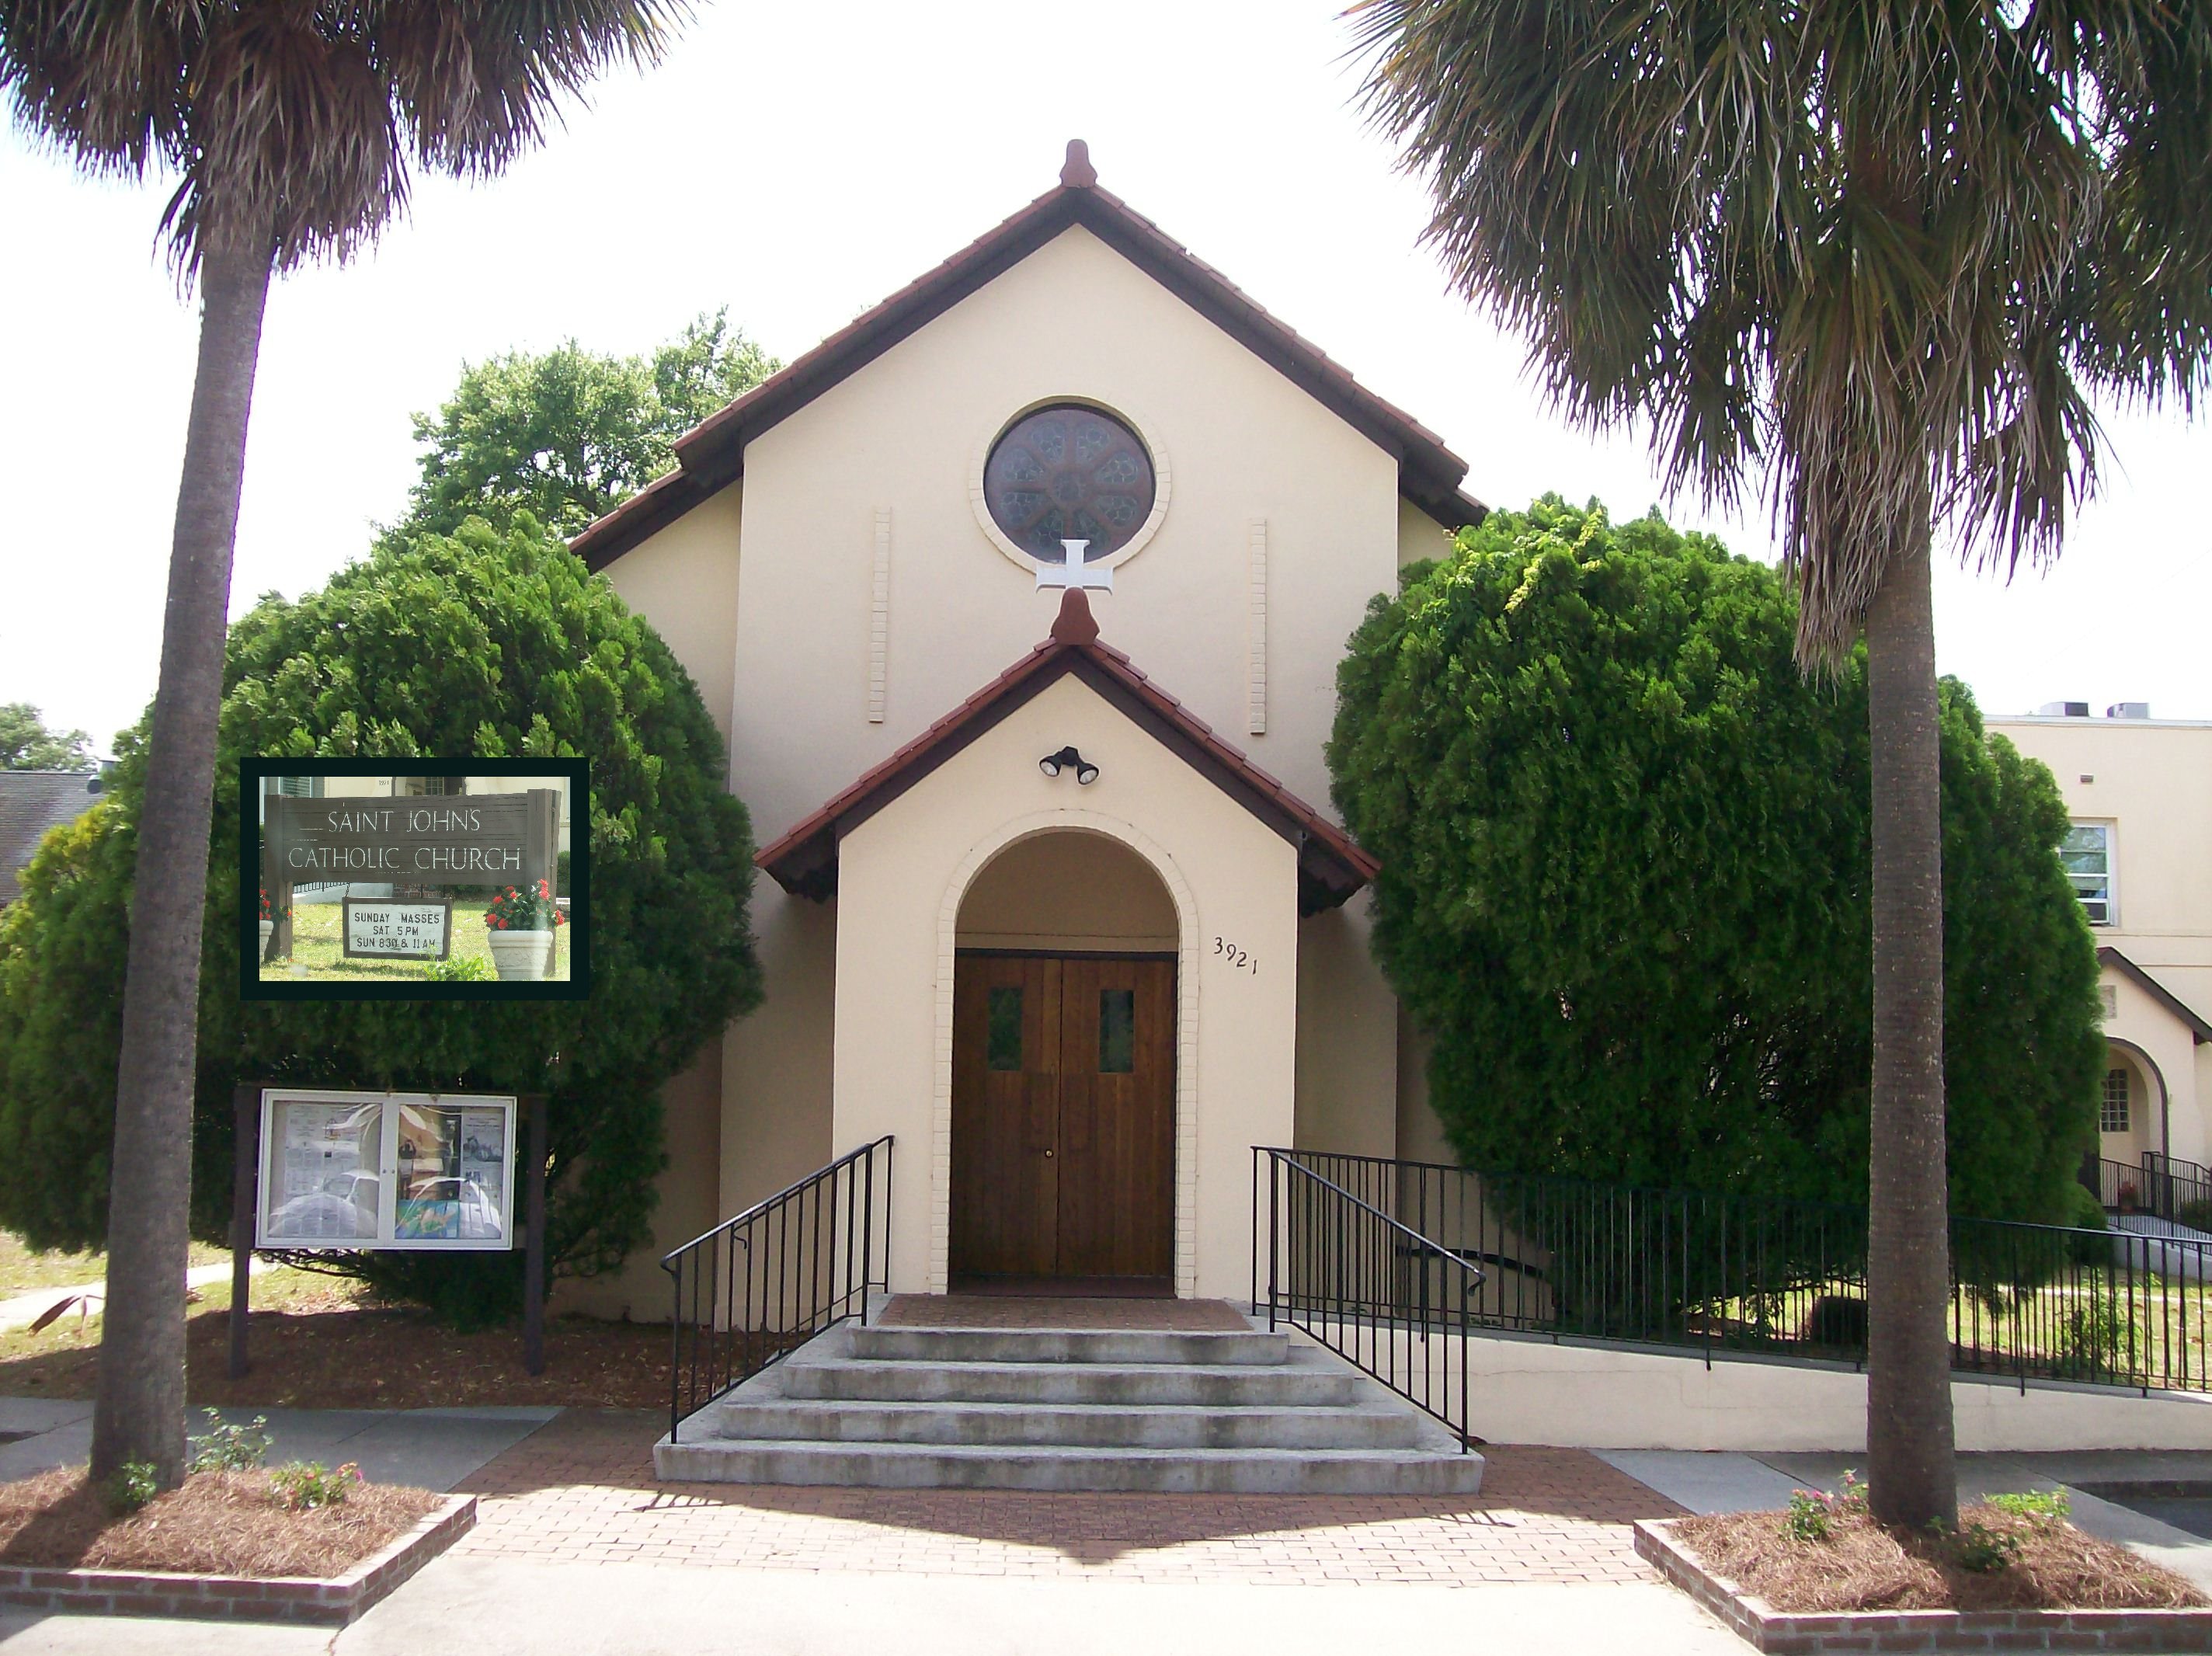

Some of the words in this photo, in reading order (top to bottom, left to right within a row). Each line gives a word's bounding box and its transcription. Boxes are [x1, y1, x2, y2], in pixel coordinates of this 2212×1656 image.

[328, 811, 394, 832] SAINT
[406, 809, 481, 832] JOHN'S
[289, 847, 400, 868] CATHOLIC
[415, 847, 520, 870] CHURCH
[354, 913, 390, 923] SUNDAY
[401, 913, 440, 924] MASSES
[405, 927, 419, 936] PM
[357, 938, 375, 947] SUN
[401, 938, 409, 948] &
[1213, 937, 1257, 975] 3921
